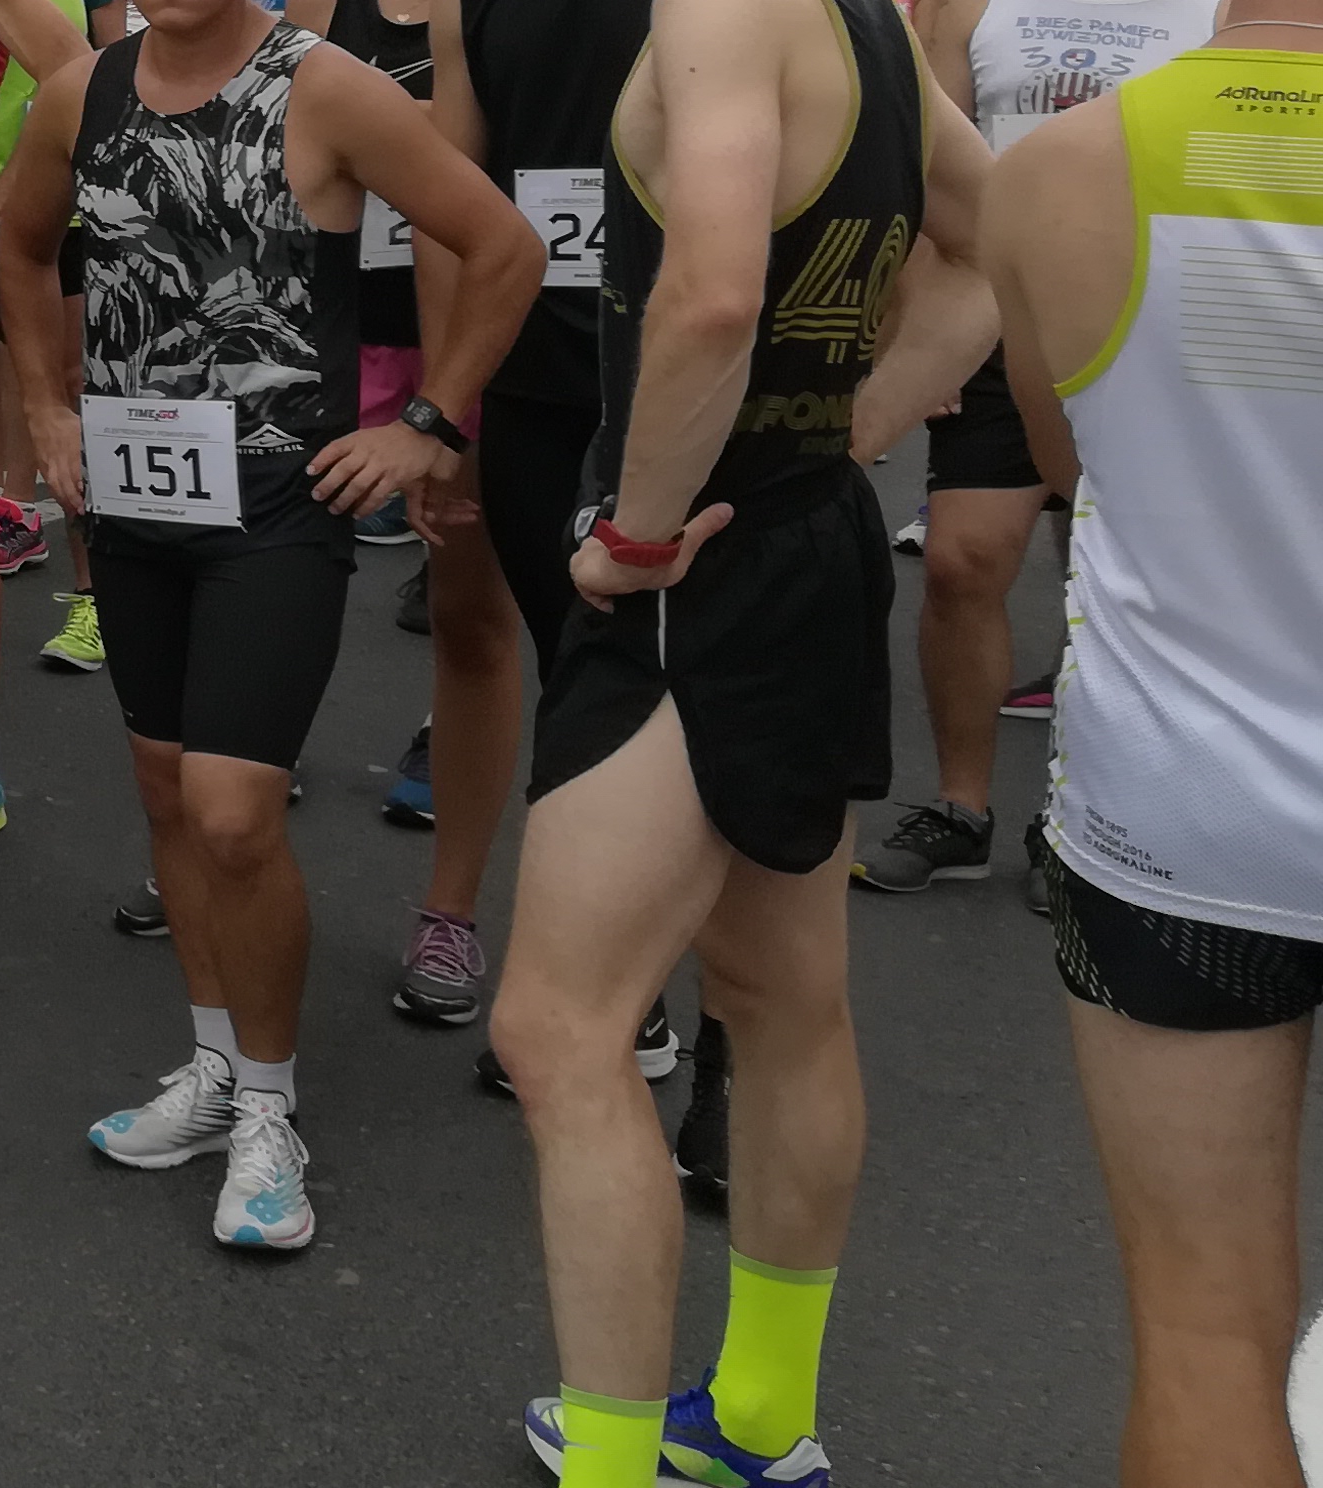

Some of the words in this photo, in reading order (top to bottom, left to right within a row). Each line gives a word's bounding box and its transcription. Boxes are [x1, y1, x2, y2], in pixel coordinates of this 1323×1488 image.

[1036, 16, 1083, 30] BIEG
[548, 213, 605, 261] 24
[268, 444, 305, 454] TRAIL
[114, 444, 212, 500] 151
